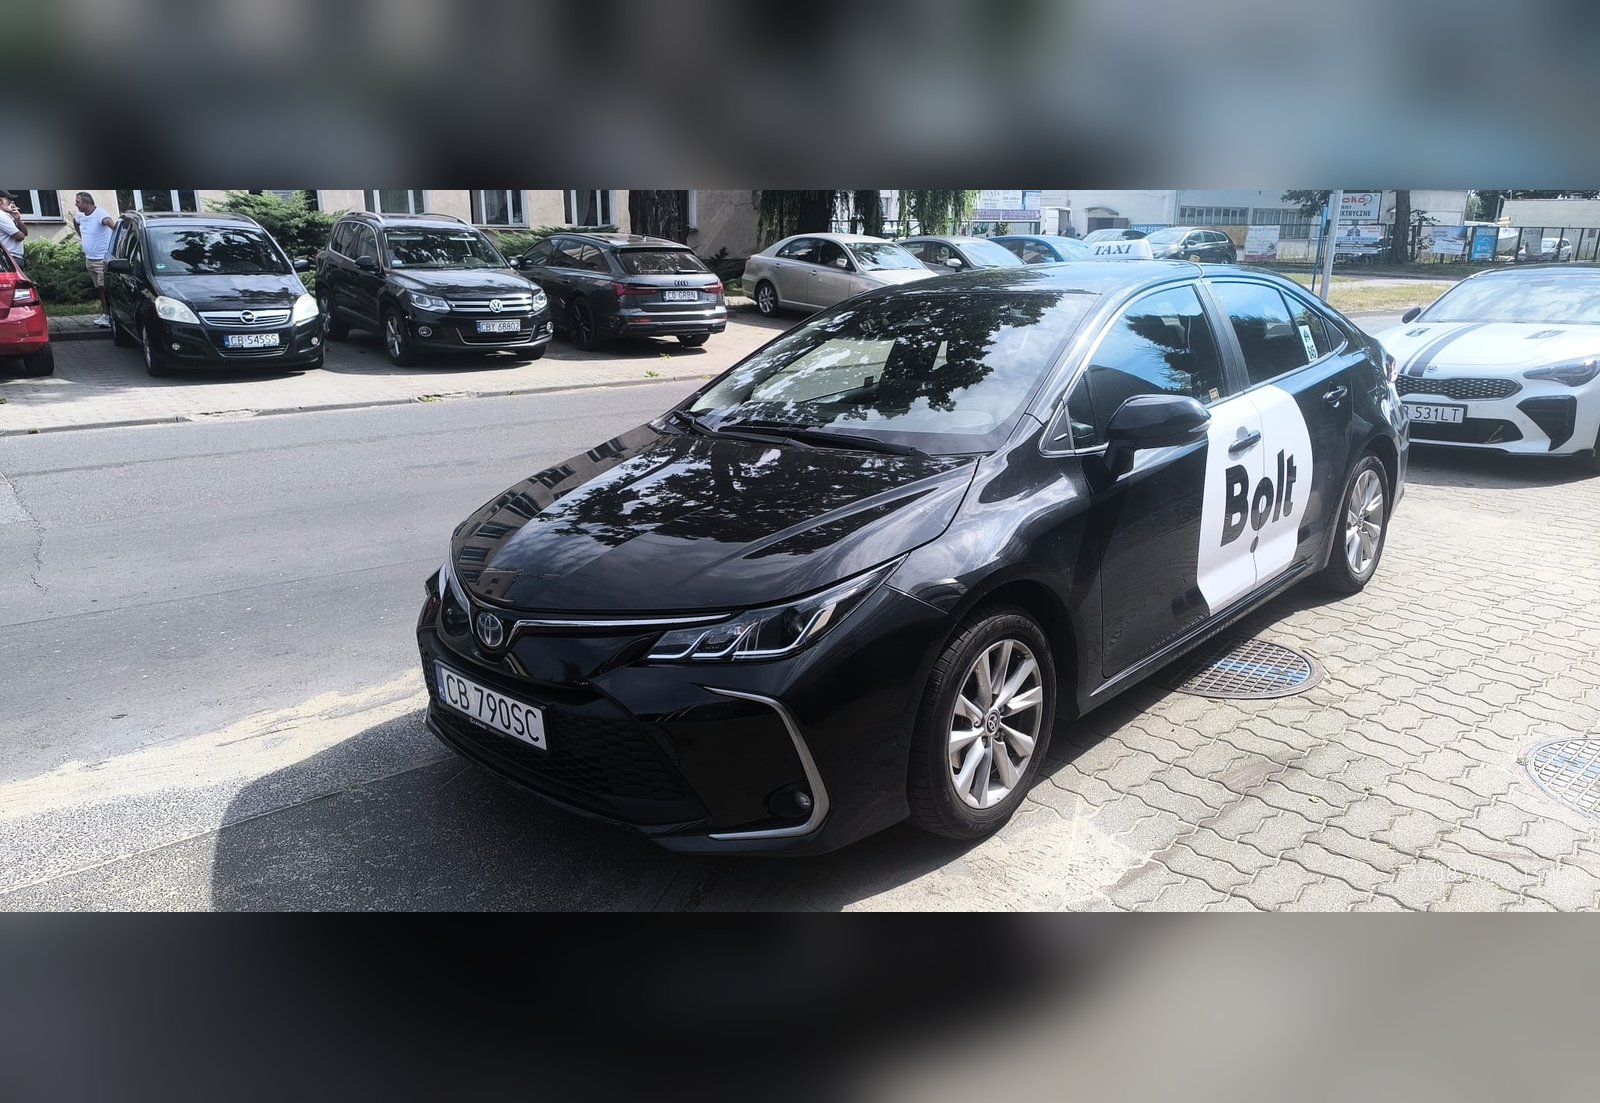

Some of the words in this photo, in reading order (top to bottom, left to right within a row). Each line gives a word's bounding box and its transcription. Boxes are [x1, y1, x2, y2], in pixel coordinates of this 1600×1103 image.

[1094, 244, 1133, 256] TAXI
[231, 335, 244, 346] CB
[247, 334, 278, 346] 545SS
[1415, 406, 1460, 421] 531LT
[1220, 449, 1297, 550] Bolt
[446, 674, 470, 710] CB
[474, 686, 540, 742] 790SC
